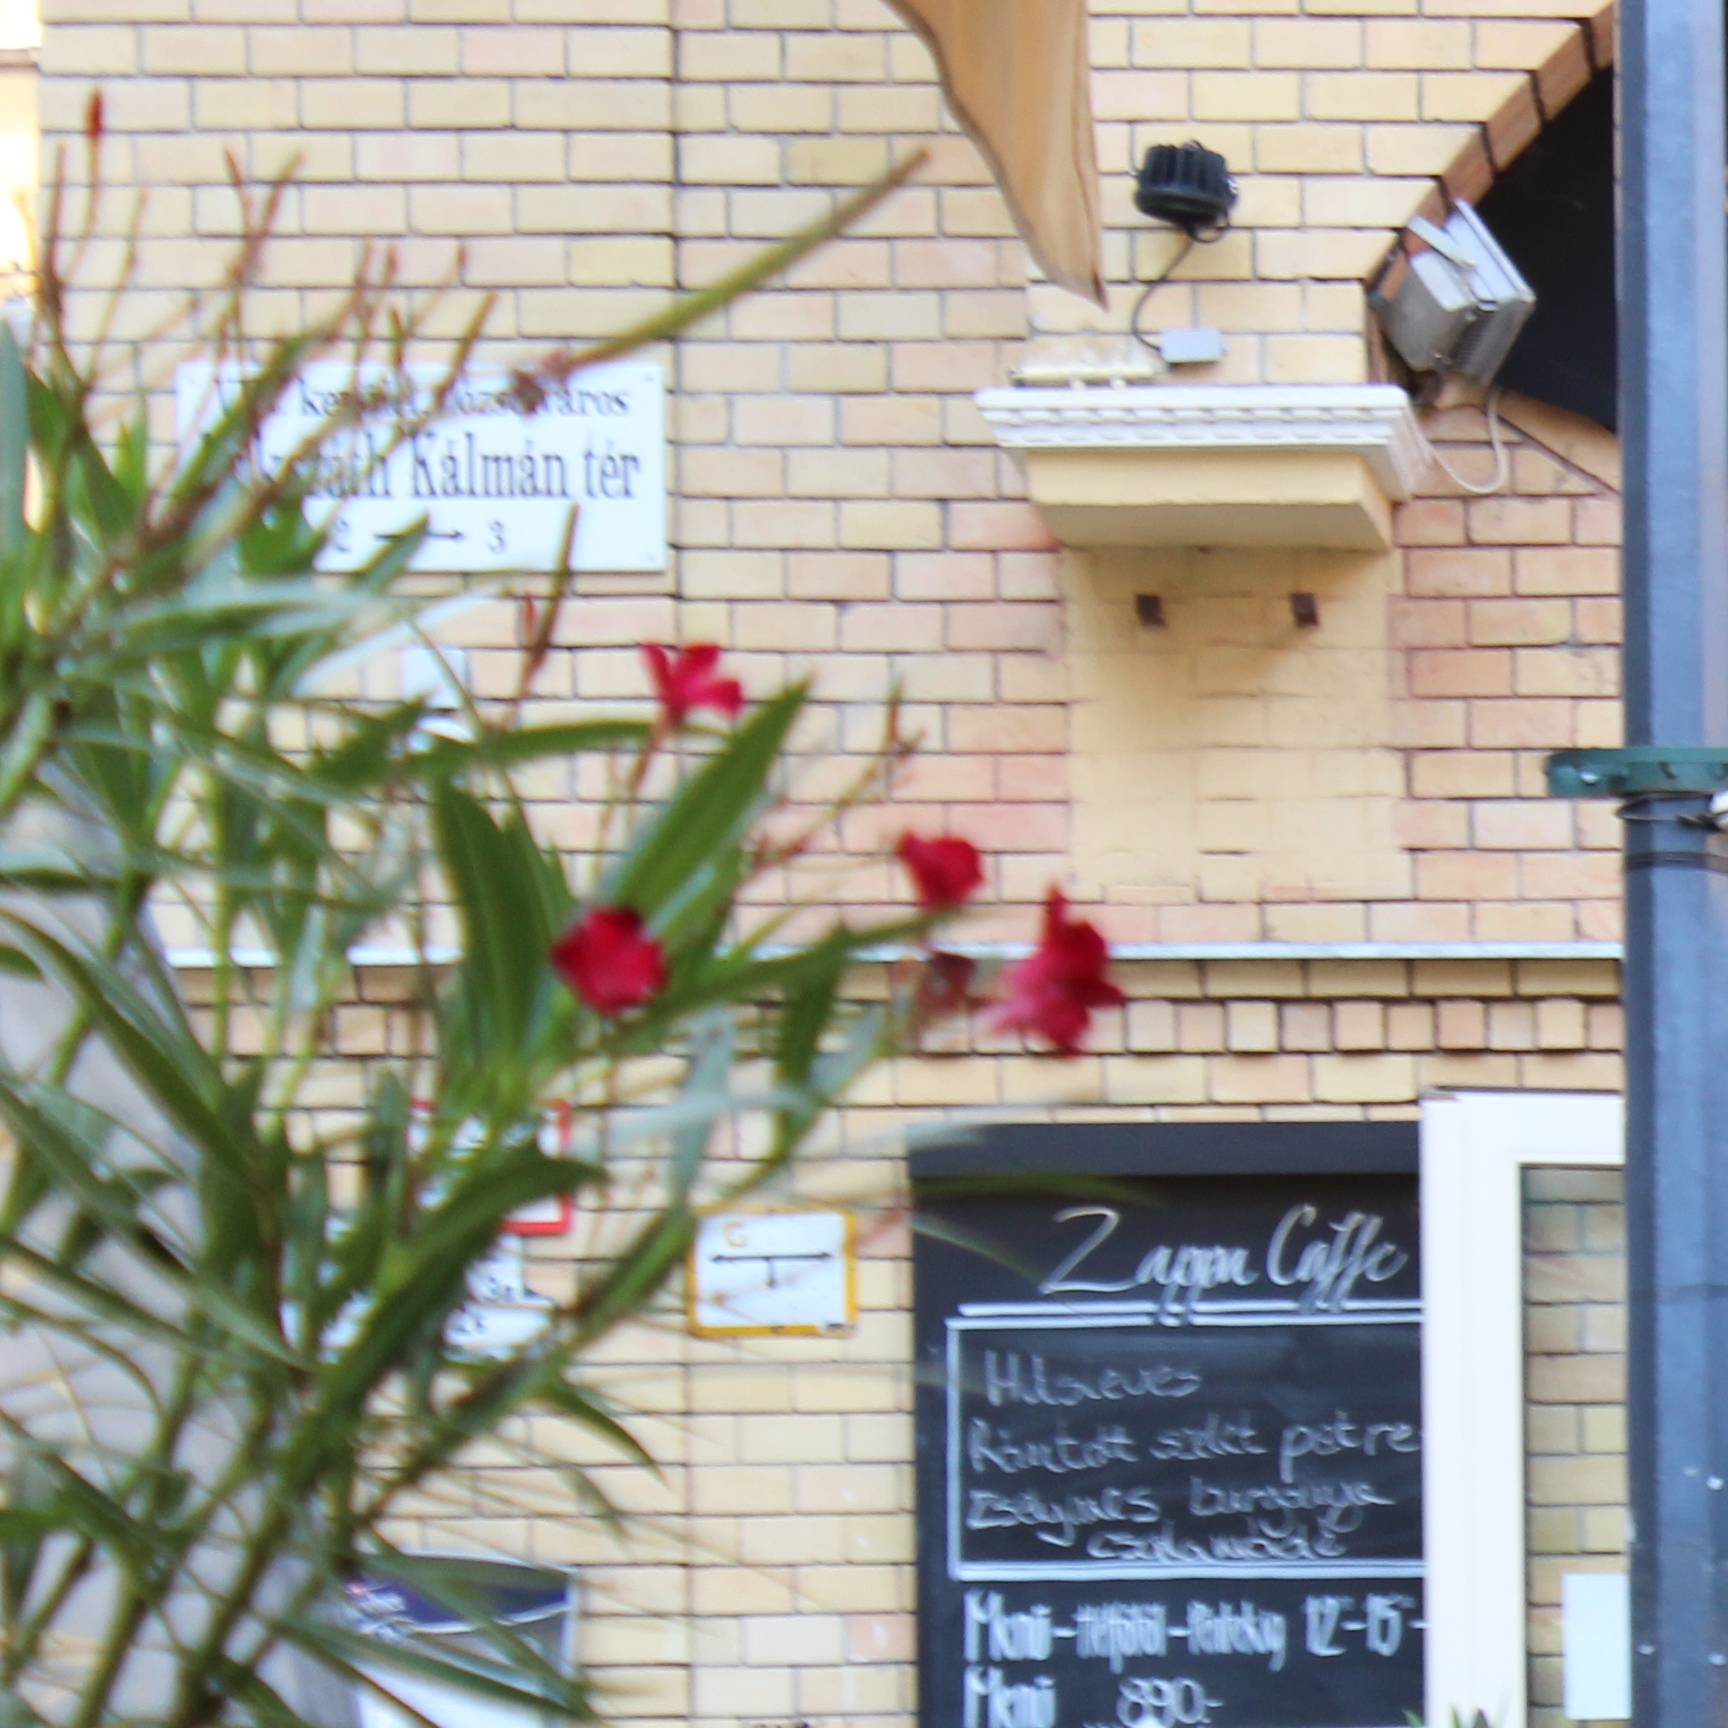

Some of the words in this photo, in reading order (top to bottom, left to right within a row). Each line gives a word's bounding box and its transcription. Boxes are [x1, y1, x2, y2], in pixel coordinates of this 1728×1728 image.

[412, 432, 568, 499] Kálmán
[584, 443, 643, 499] tér
[487, 520, 507, 554] 3
[1038, 1205, 1261, 1326] Zappa
